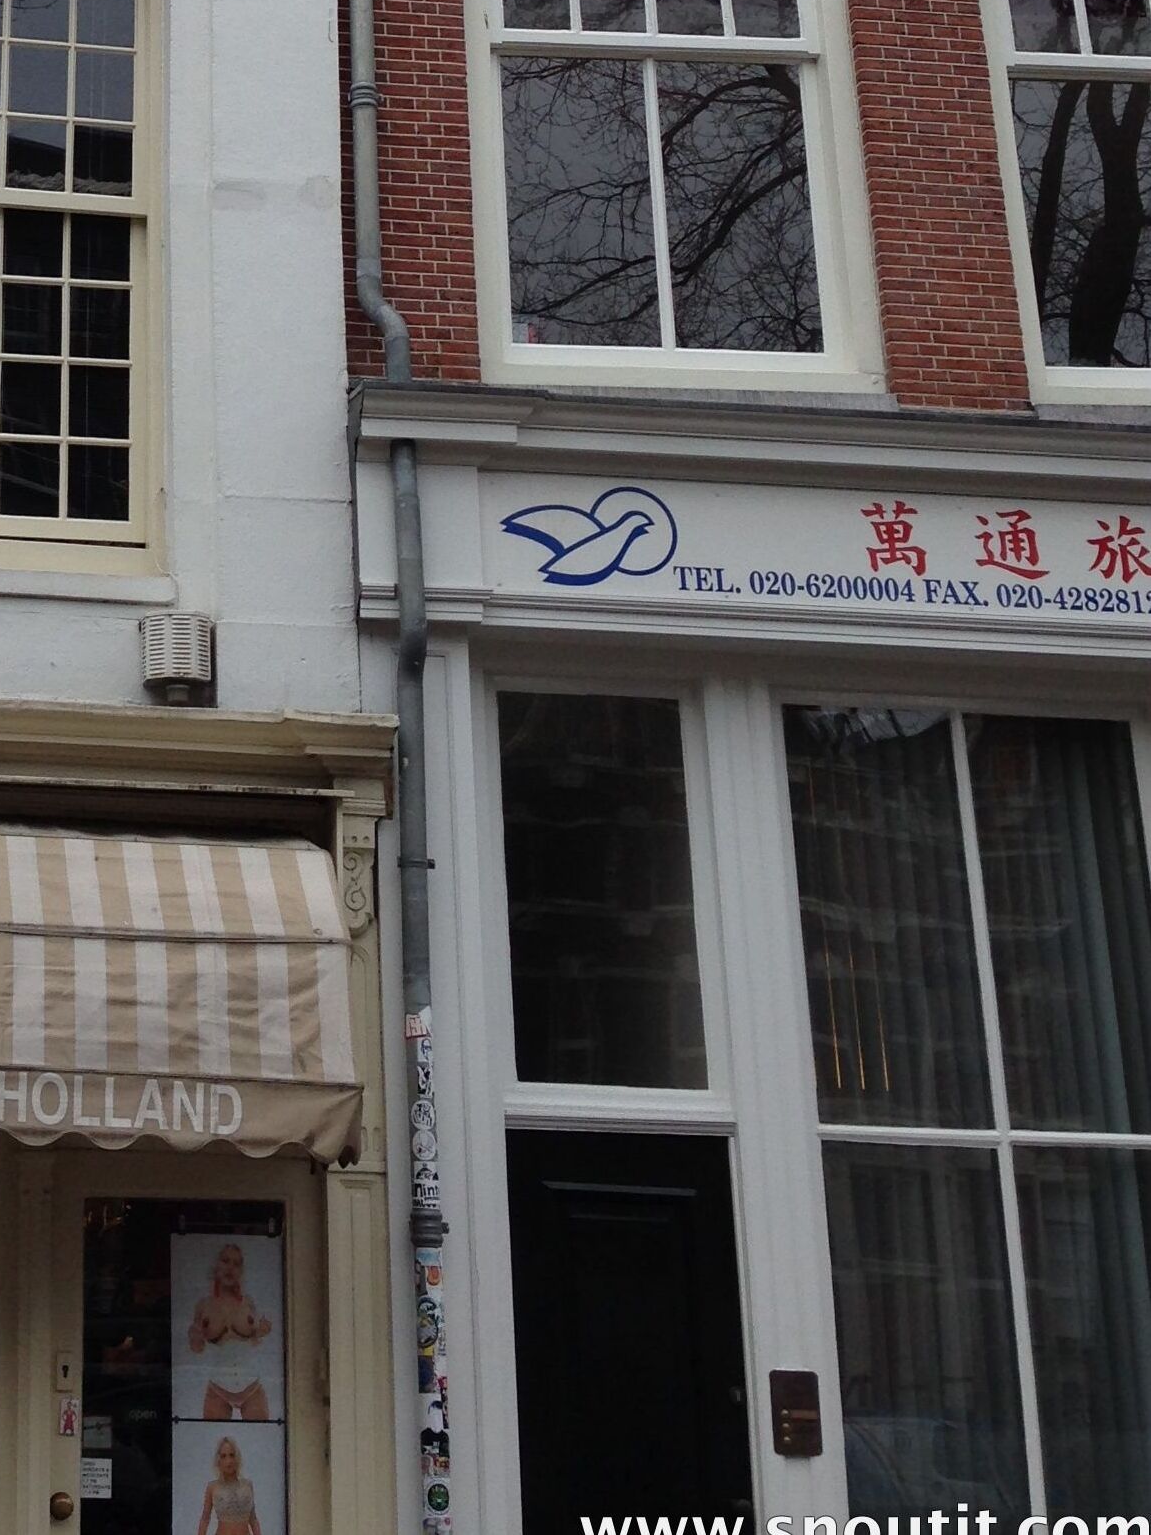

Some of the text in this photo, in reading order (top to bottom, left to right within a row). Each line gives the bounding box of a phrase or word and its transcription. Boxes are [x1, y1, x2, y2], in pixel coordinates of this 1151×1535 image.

[673, 566, 741, 594] TEL.
[749, 570, 916, 602] 020-6200004
[923, 579, 989, 607] FAX.
